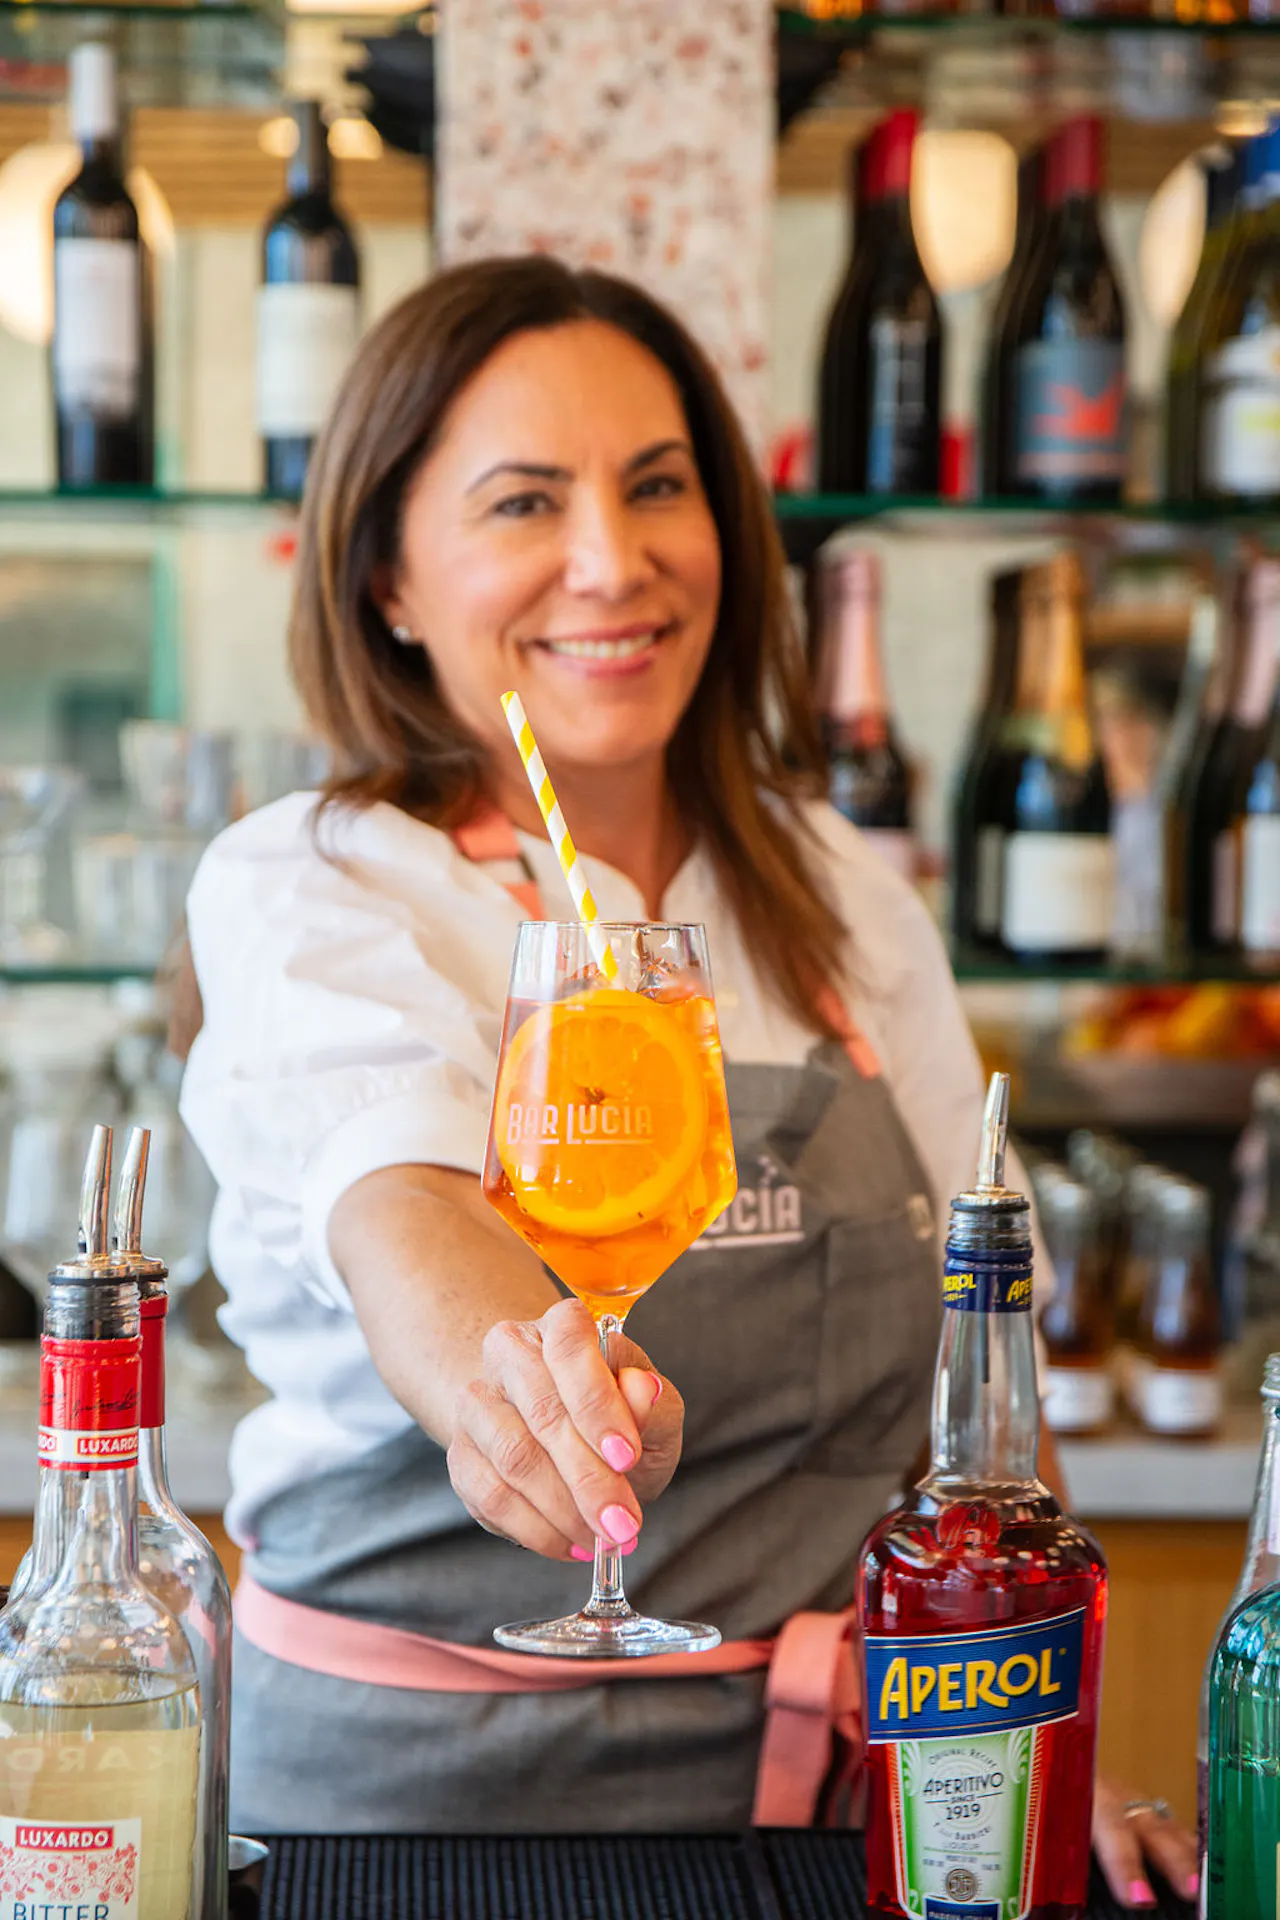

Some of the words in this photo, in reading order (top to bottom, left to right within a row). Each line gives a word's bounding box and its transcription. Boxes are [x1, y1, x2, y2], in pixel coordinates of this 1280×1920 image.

[507, 1103, 559, 1144] BAR
[1006, 1275, 1032, 1302] APE
[879, 1648, 1061, 1720] APEROL
[923, 1771, 1005, 1796] APERITIVO
[946, 1803, 981, 1820] 1919
[19, 1829, 109, 1848] LUXARDO
[13, 1902, 110, 1920] BITTER
